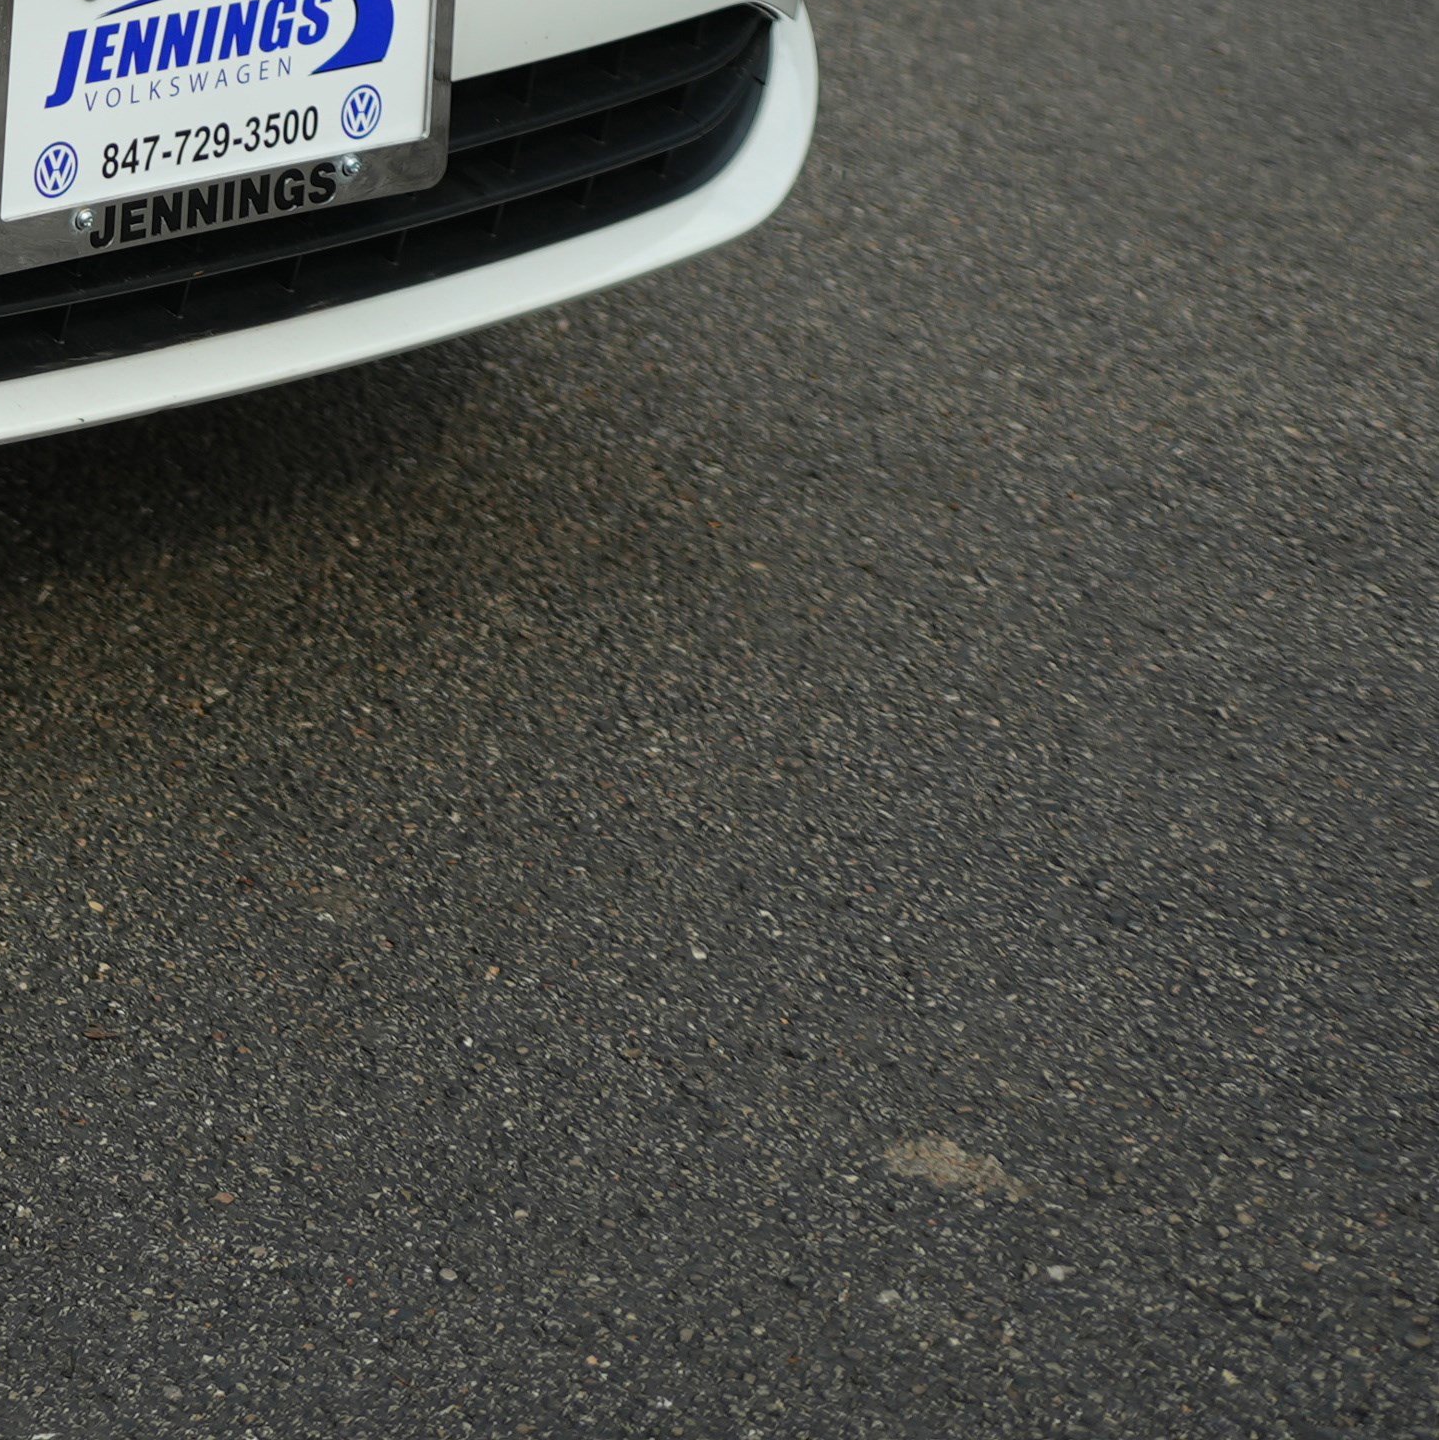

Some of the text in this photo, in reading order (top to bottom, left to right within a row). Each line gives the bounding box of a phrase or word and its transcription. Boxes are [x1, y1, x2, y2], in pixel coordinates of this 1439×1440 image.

[83, 55, 293, 112] VOLKSWAGEN
[101, 104, 320, 180] 847-729-3500
[89, 161, 337, 249] JENNINGS
